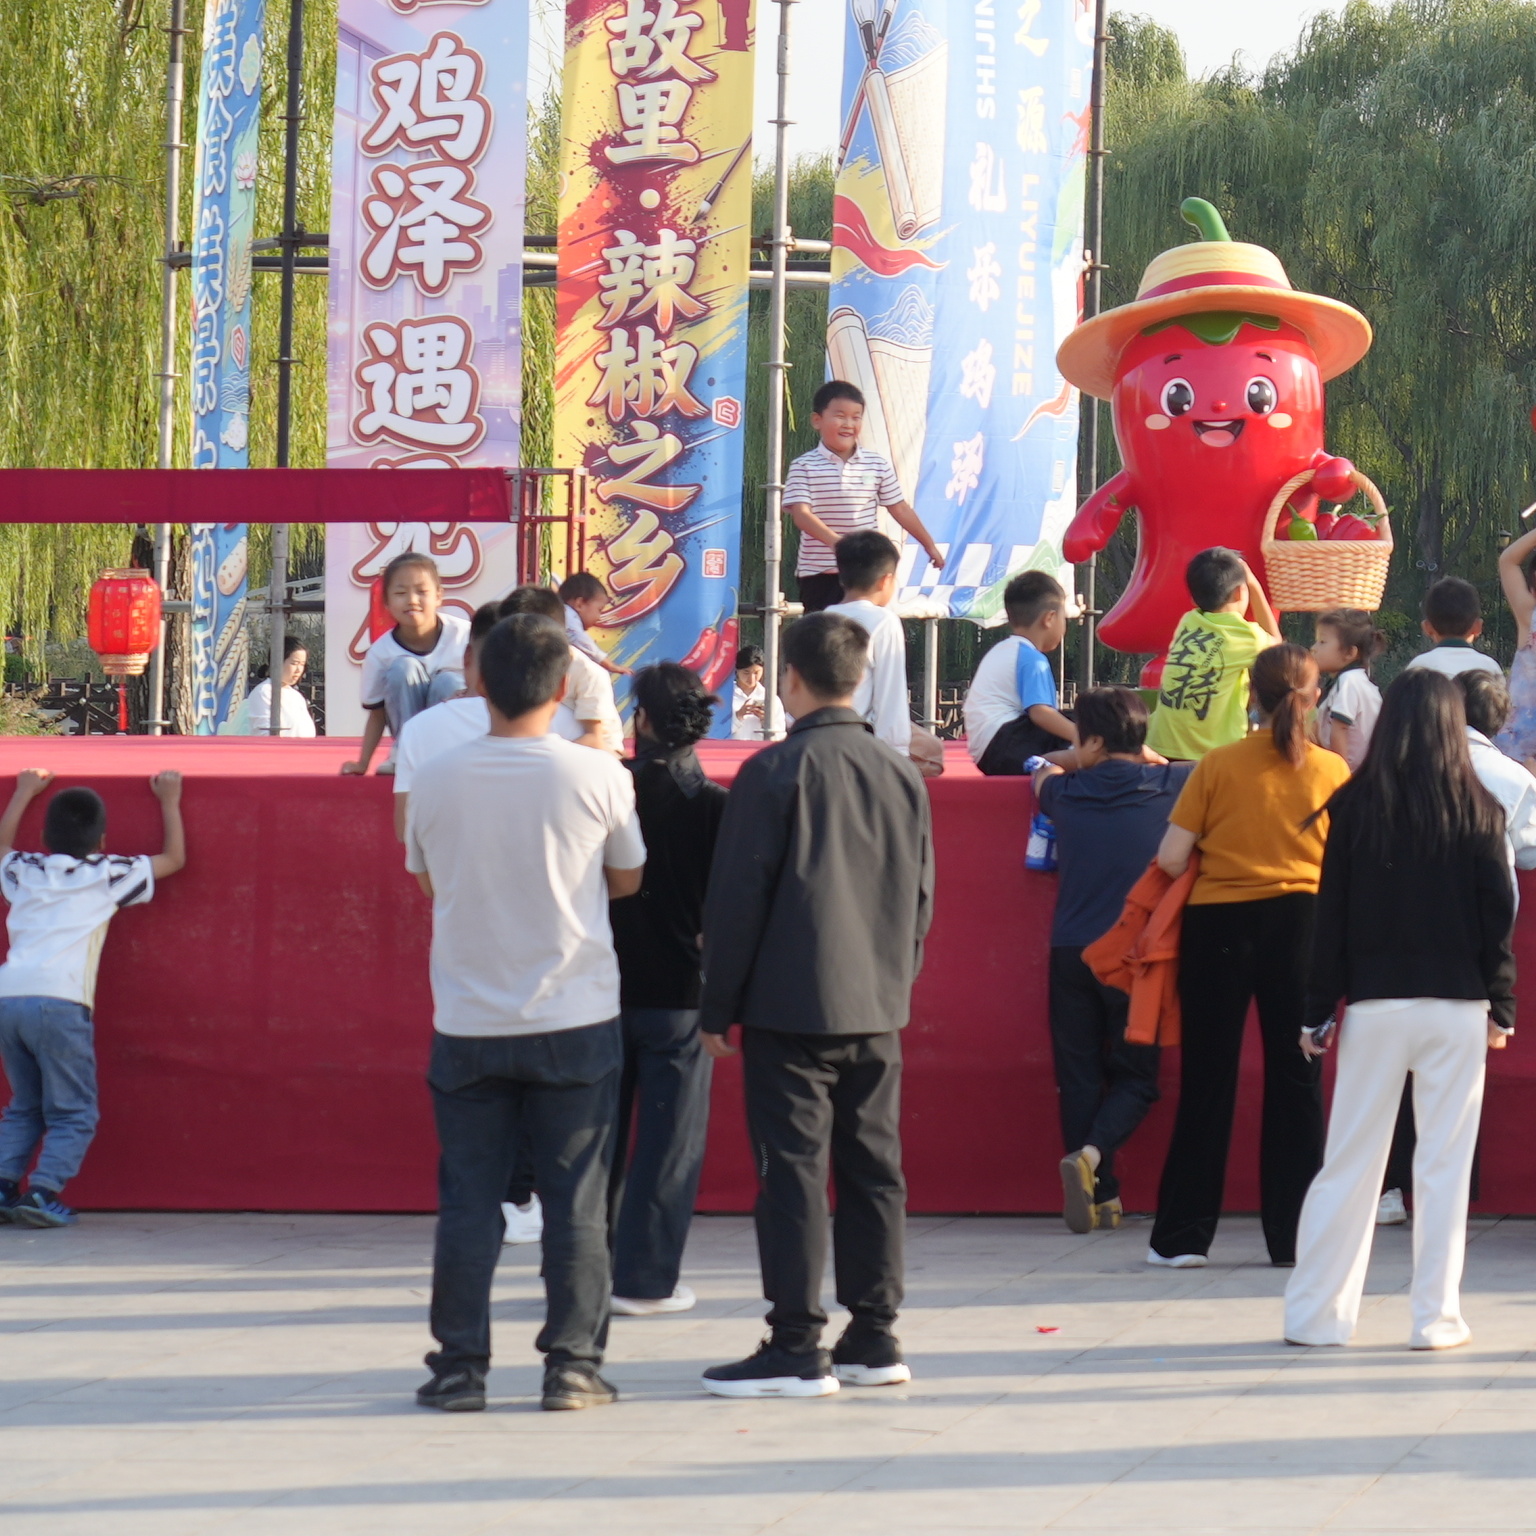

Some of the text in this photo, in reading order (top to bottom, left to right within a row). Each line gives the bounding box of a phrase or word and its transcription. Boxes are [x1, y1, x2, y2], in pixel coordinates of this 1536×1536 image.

[943, 141, 1008, 507] 礼乐鸡泽
[1010, 173, 1039, 395] LIYUEJIZE
